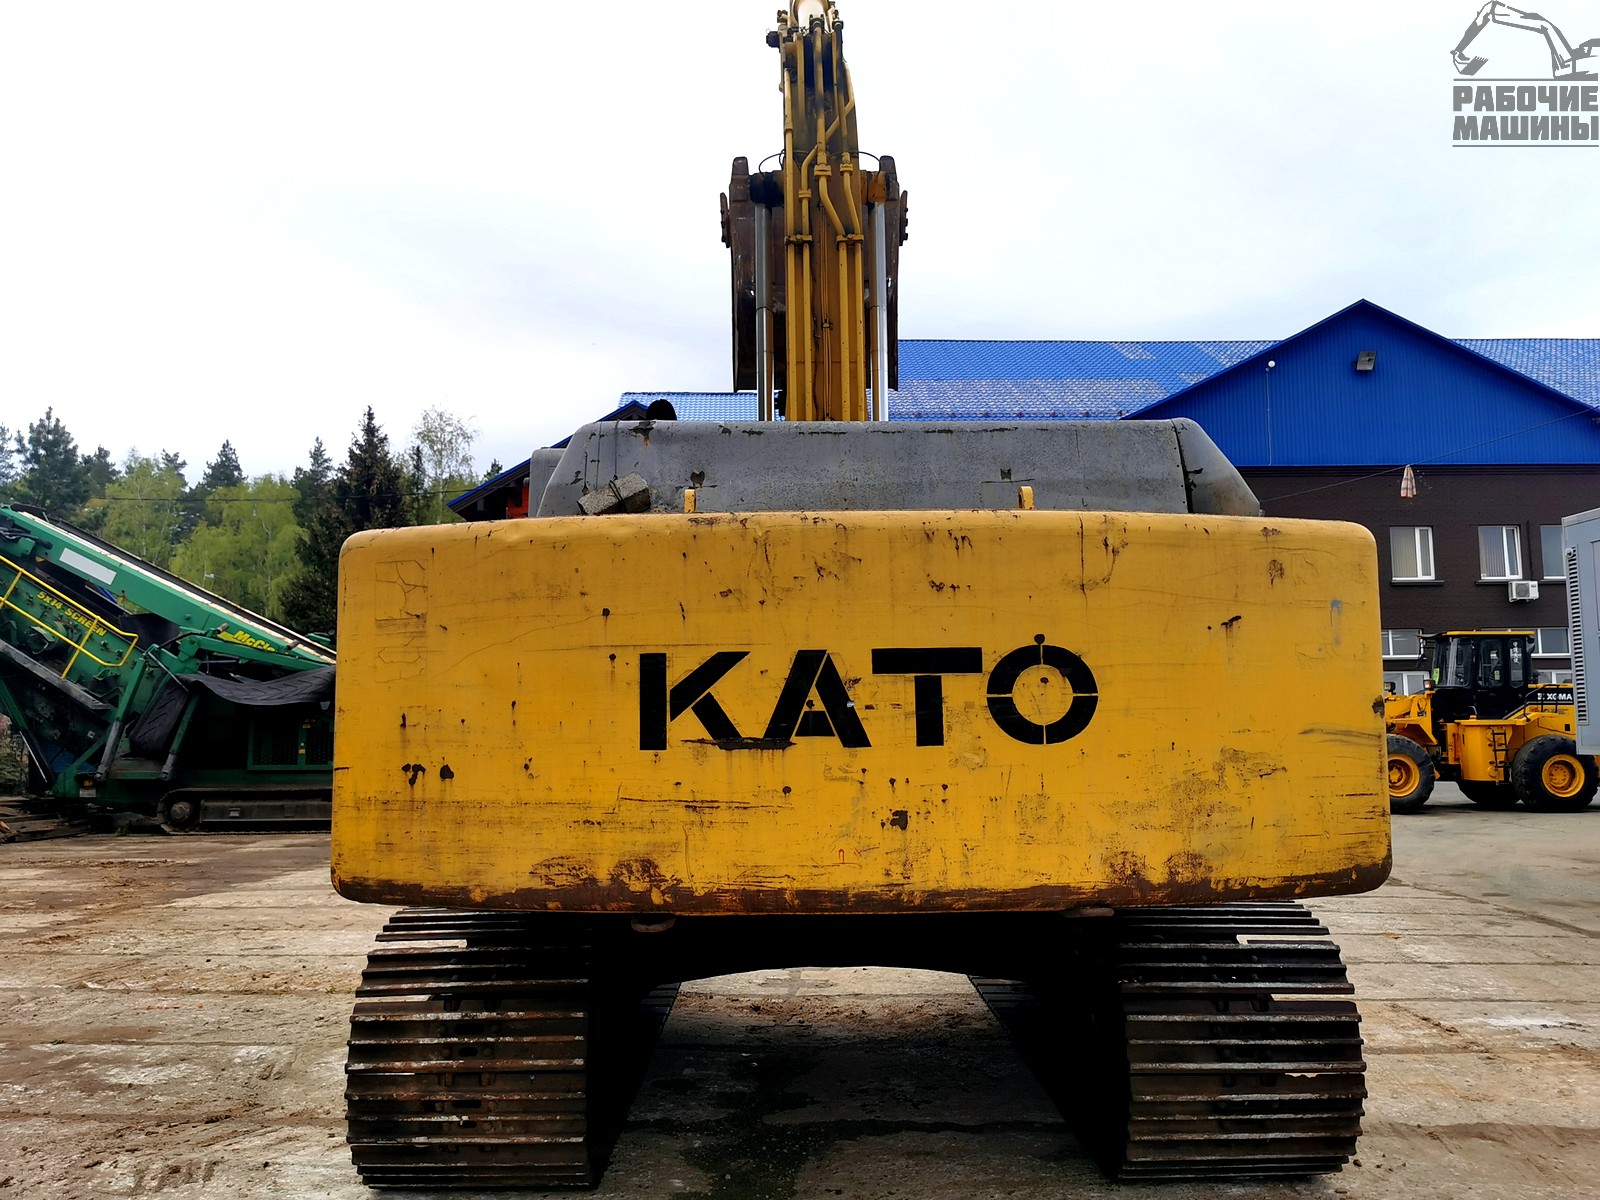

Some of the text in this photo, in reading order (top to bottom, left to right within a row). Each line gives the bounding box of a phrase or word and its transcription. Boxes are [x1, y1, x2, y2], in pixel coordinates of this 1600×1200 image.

[64, 608, 107, 636] SCREEN
[232, 630, 277, 652] McClo
[639, 644, 1099, 751] KATO
